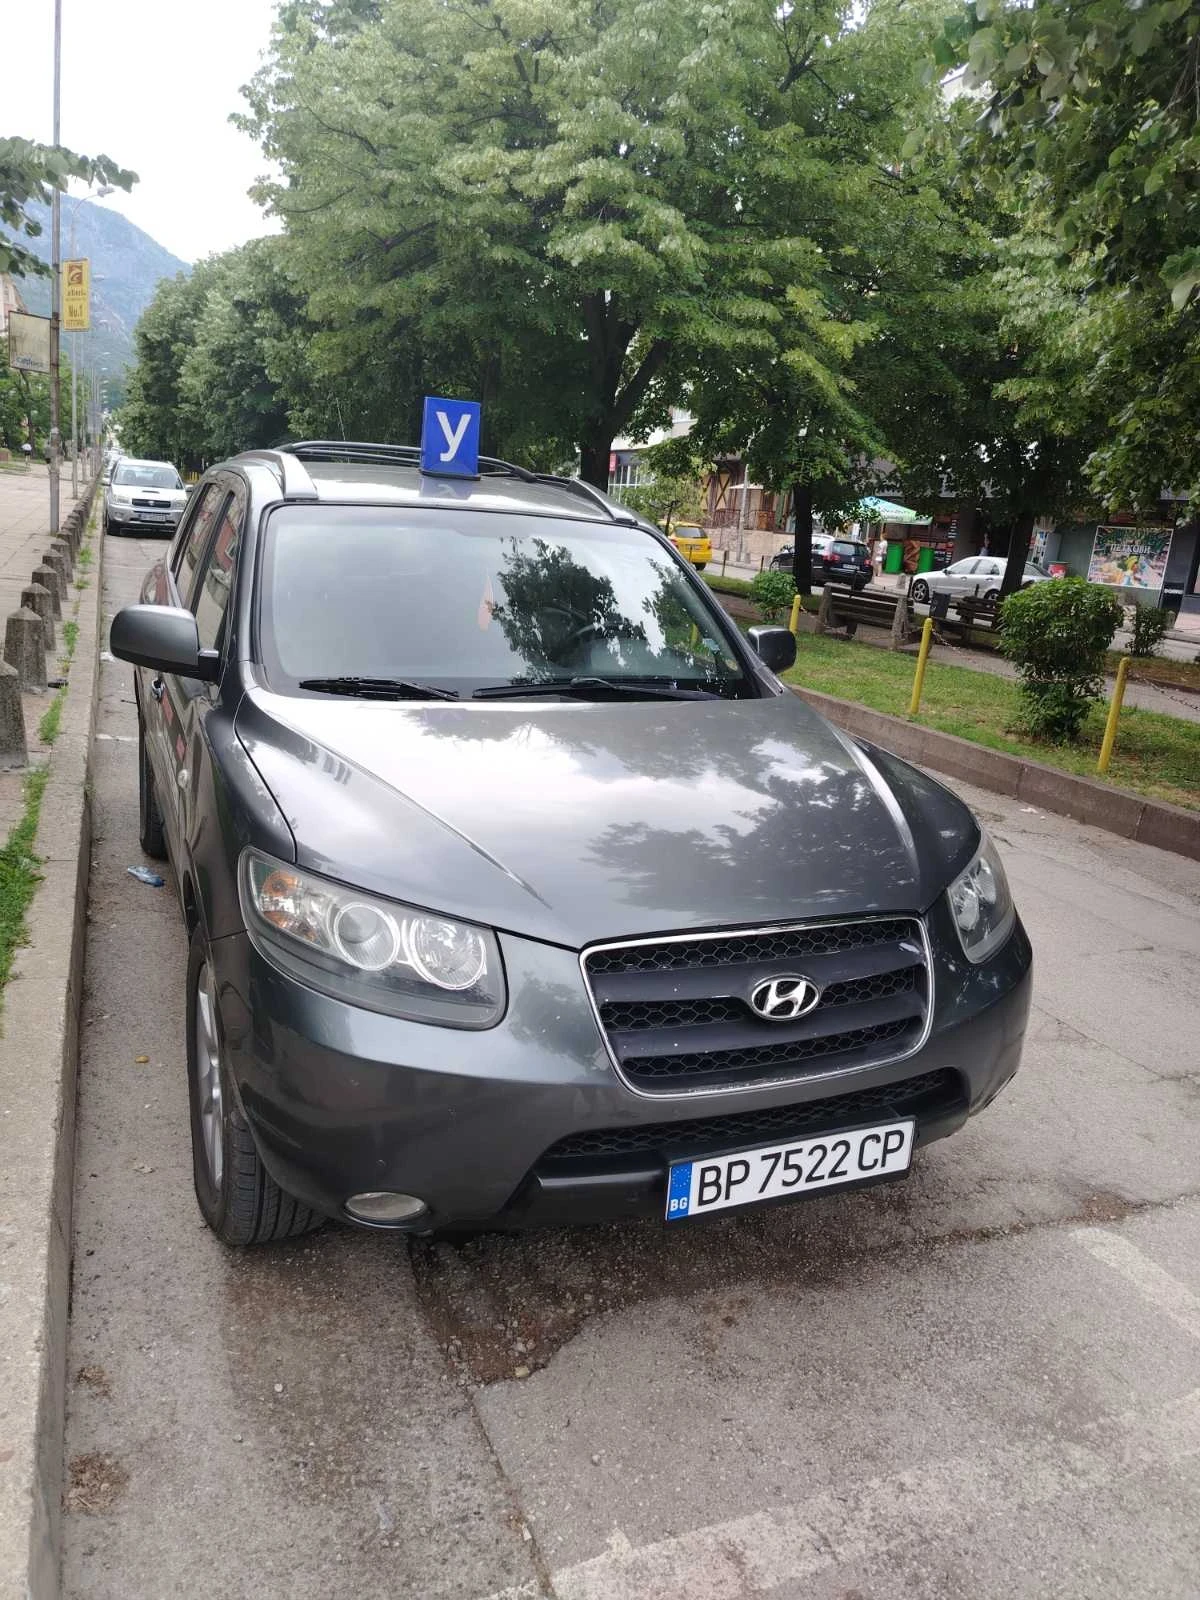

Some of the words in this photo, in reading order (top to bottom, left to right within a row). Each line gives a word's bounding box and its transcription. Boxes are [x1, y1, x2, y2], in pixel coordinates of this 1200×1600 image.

[697, 1159, 750, 1207] BP
[758, 1139, 851, 1194] 7522
[857, 1129, 905, 1172] CP
[670, 1197, 688, 1212] BG
